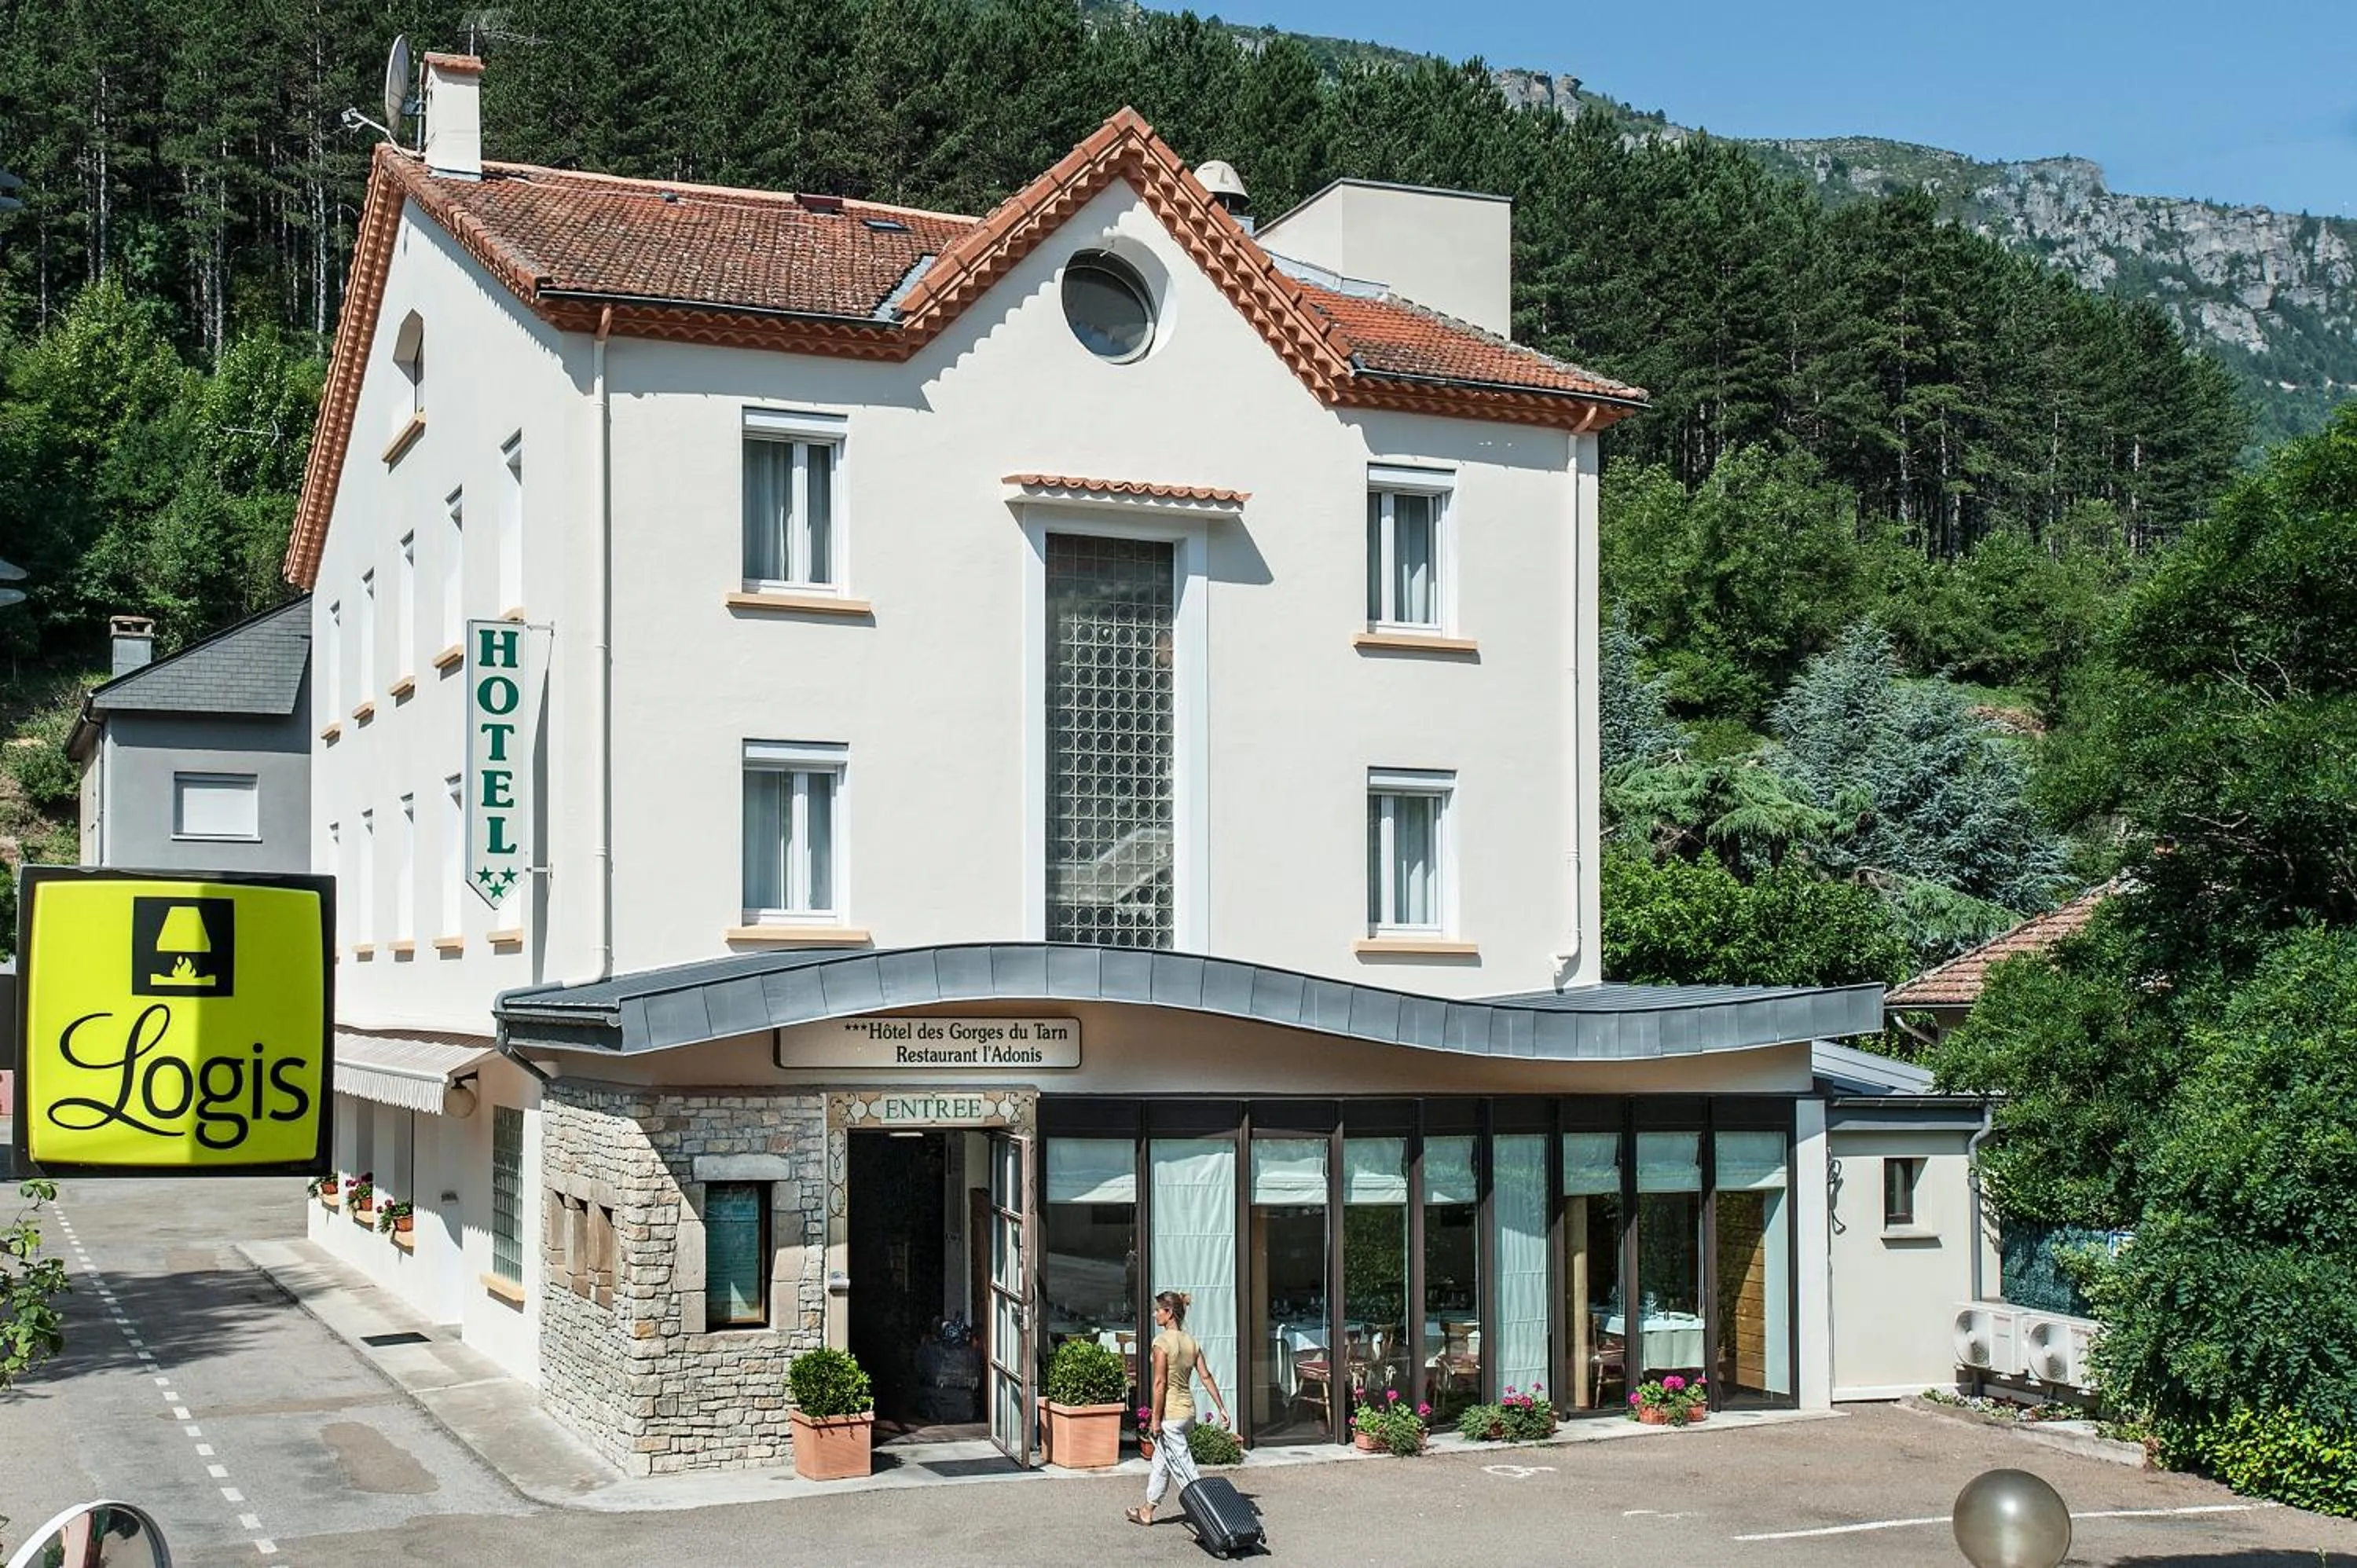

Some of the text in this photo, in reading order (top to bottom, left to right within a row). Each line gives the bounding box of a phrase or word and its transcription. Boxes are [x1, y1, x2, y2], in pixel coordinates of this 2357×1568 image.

[477, 629, 519, 855] HOTEL
[868, 1021, 1068, 1044] Hôtel des Gorges du Tarn
[896, 1045, 1043, 1063] Restaurant l'Adonis
[47, 1003, 310, 1149] Logis
[885, 1099, 982, 1119] ENTREE
